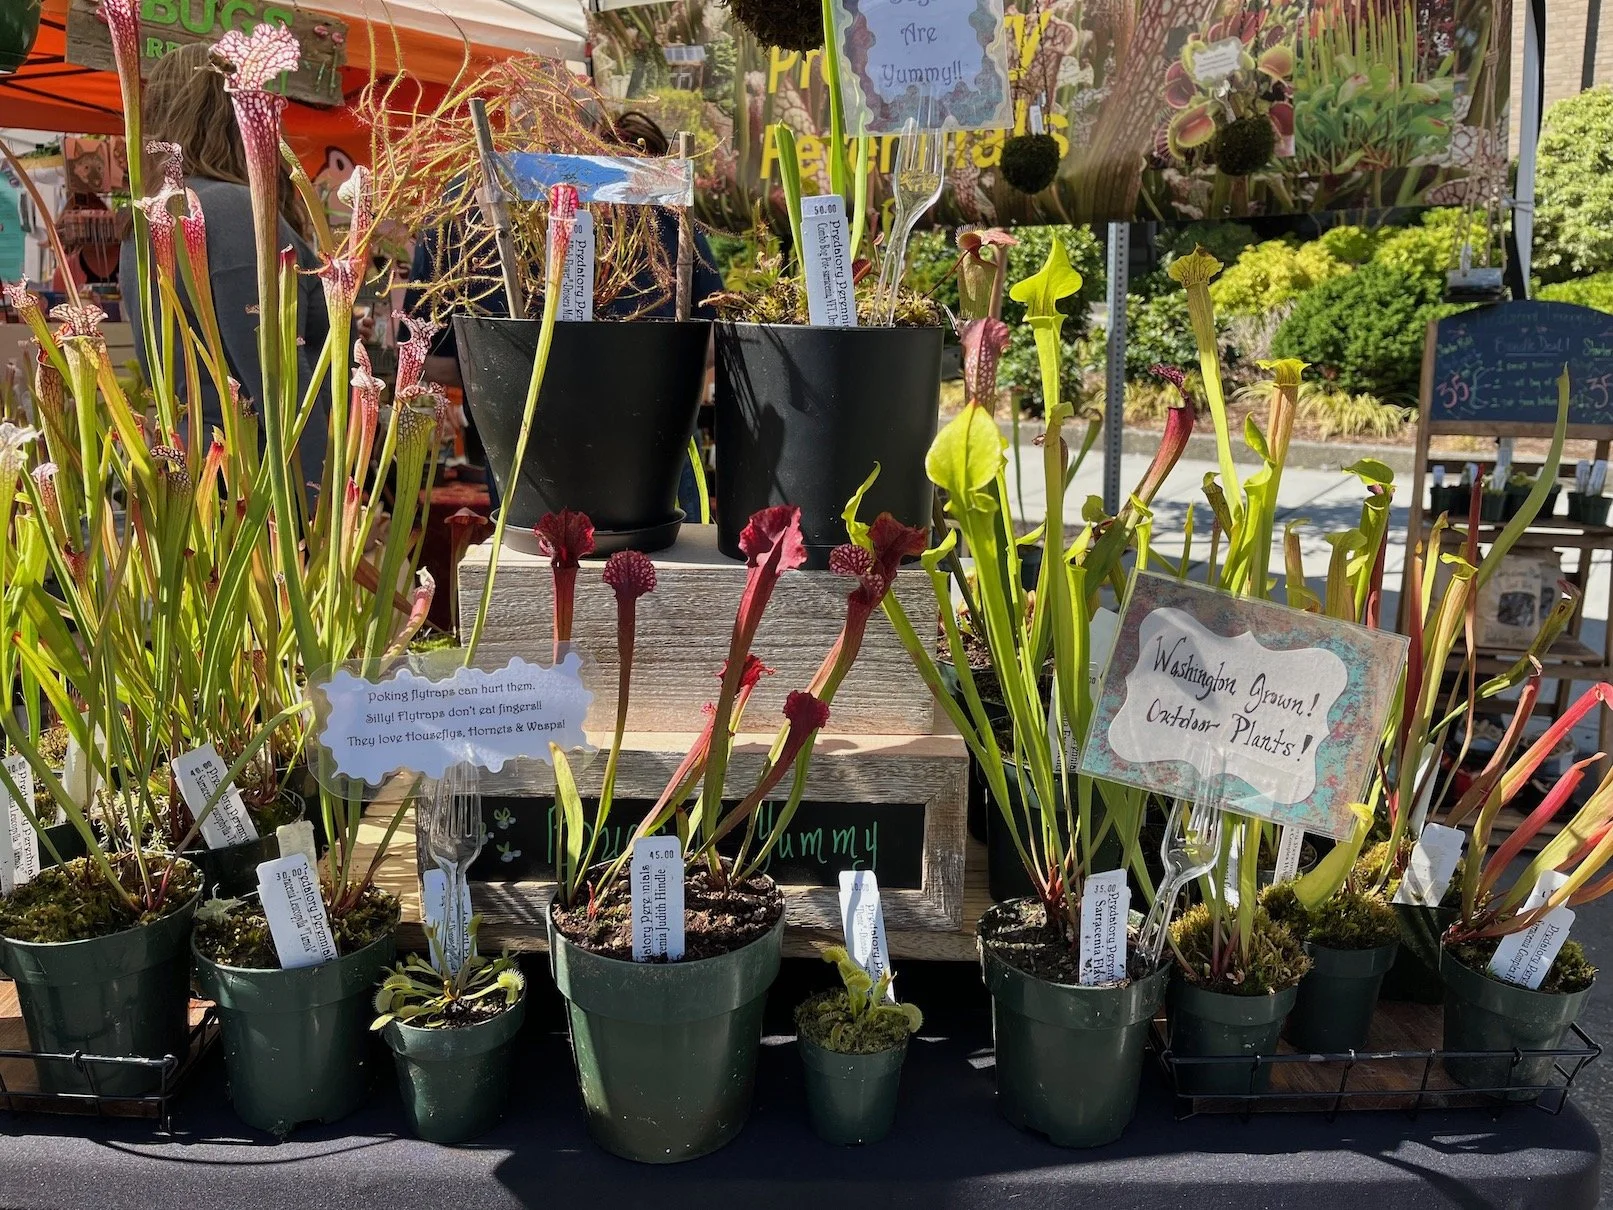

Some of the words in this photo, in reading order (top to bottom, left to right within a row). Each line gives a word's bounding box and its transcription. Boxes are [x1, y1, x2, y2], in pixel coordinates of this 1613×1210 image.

[900, 22, 938, 46] Are
[881, 60, 963, 87] Yummy!!
[814, 204, 837, 215] 50.00
[829, 219, 844, 278] Predatory
[575, 239, 587, 298] Predatory
[836, 280, 850, 327] Perenni
[368, 690, 409, 704] Poking
[411, 687, 456, 702] flytraps
[458, 685, 478, 696] can
[481, 682, 504, 694] hurt
[507, 681, 536, 692] them.
[1153, 636, 1237, 701] Washington
[1244, 672, 1320, 718] Grown!
[365, 711, 395, 725] Silly!
[397, 708, 446, 723] Flytraps
[448, 704, 476, 718] don't
[478, 704, 496, 716] eat
[498, 699, 542, 716] fingers!!
[1146, 697, 1220, 733] Outdoor
[1231, 713, 1313, 762] Plants!
[347, 735, 375, 748] They
[378, 733, 403, 744] love
[468, 724, 513, 737] Hornets
[515, 722, 525, 733] &
[526, 718, 566, 732] Wasps!
[206, 767, 233, 810] Preory
[649, 849, 674, 860] 45.00
[753, 801, 878, 873] Yummy
[275, 867, 303, 881] 30.00
[654, 868, 666, 901] Hindle
[1094, 883, 1117, 894] 35.00
[639, 864, 653, 925] Perenials
[655, 902, 670, 931] Judith
[866, 903, 880, 959] Predatory
[1093, 899, 1106, 956] Sarracenia
[1106, 891, 1120, 943] Predatory
[1509, 947, 1529, 976] Complex
[1531, 923, 1560, 966] Predatory
